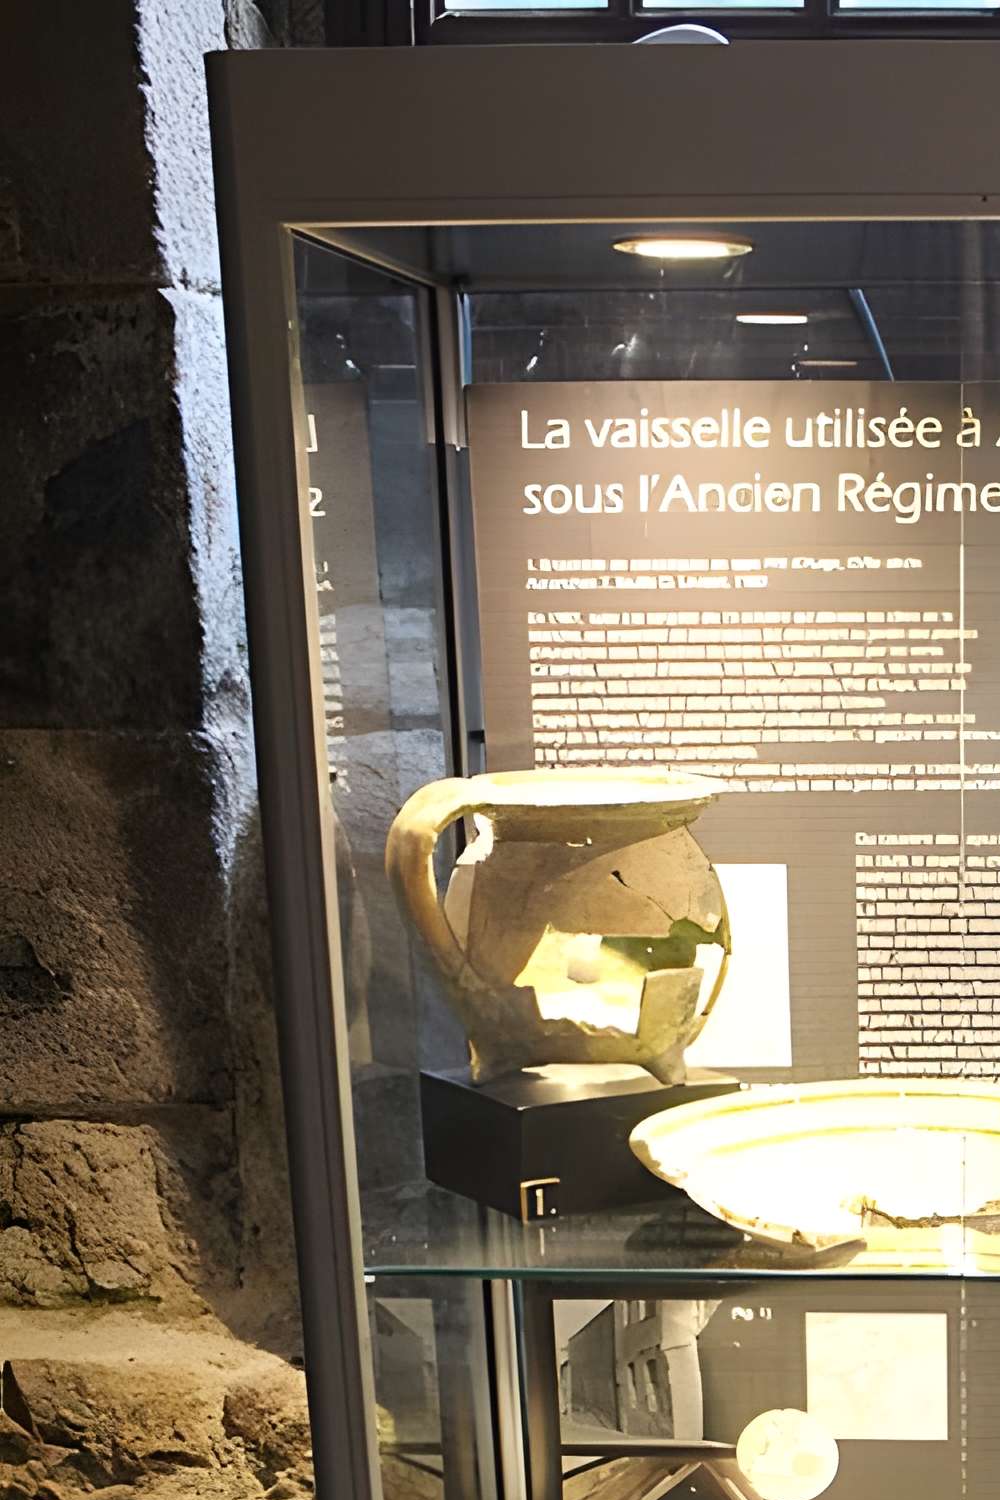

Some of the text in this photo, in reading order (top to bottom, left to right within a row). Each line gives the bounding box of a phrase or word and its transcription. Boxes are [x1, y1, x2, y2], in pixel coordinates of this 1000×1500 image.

[520, 410, 571, 450] La
[584, 407, 771, 449] vaisselle
[785, 407, 942, 449] utilisée
[956, 407, 982, 449] à
[522, 482, 625, 515] sous
[639, 472, 822, 514] l'Ancien
